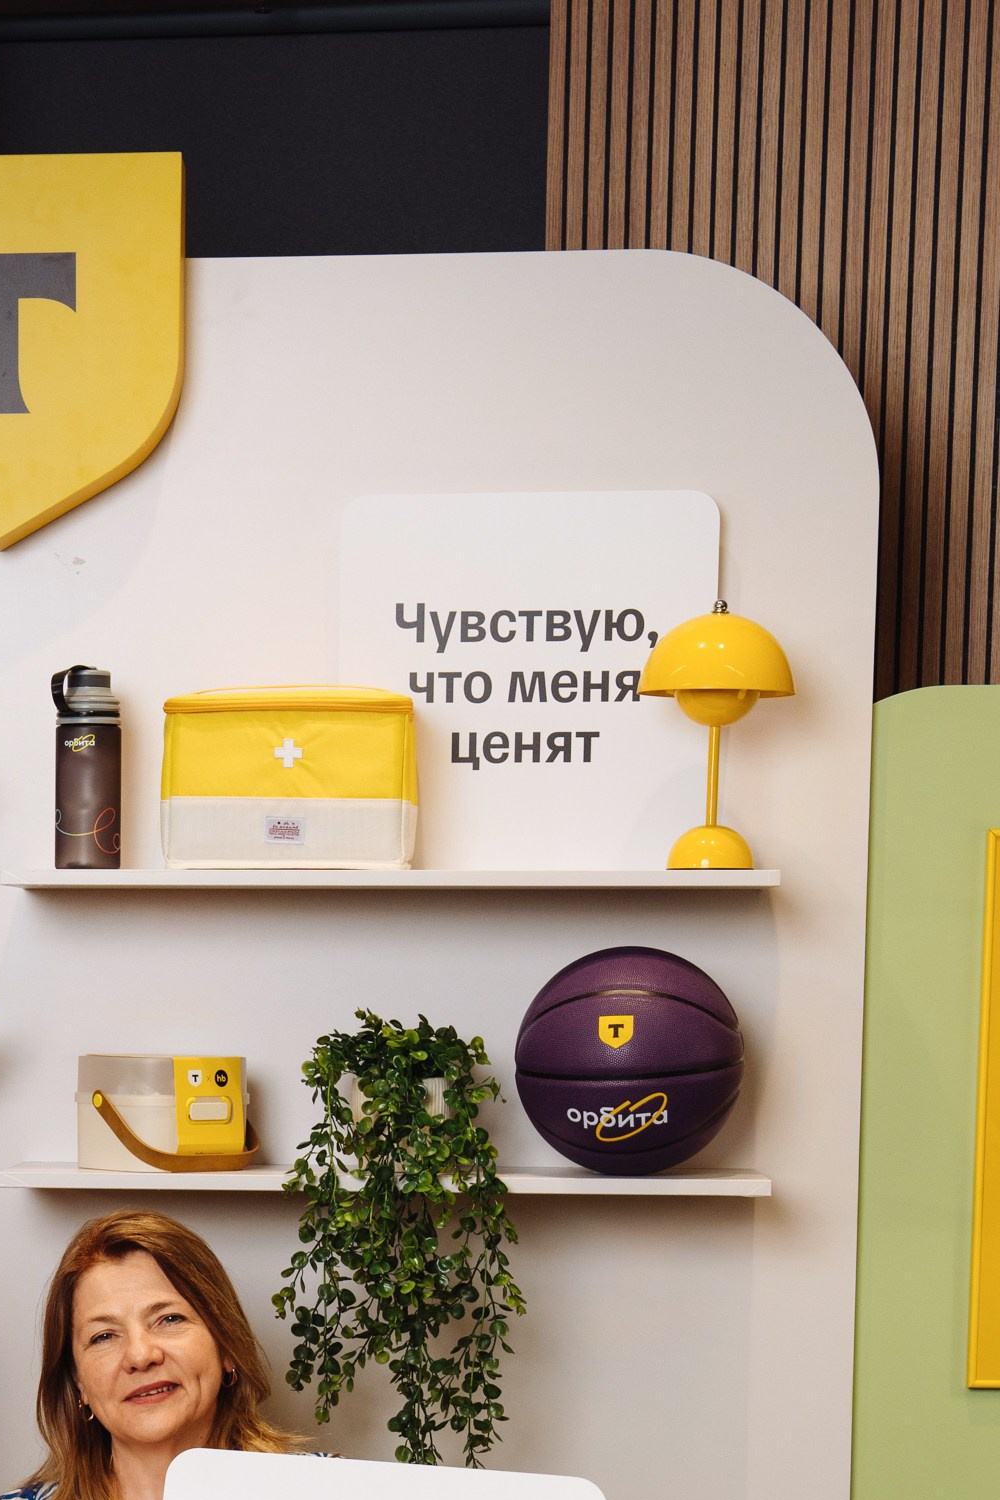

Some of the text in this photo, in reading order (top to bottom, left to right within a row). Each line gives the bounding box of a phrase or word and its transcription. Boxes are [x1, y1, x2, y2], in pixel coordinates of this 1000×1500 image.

[395, 603, 659, 653] Чувствую,
[409, 670, 641, 704] что меня
[451, 730, 600, 771] ценят
[607, 1023, 625, 1038] Т
[191, 1074, 199, 1083] Т
